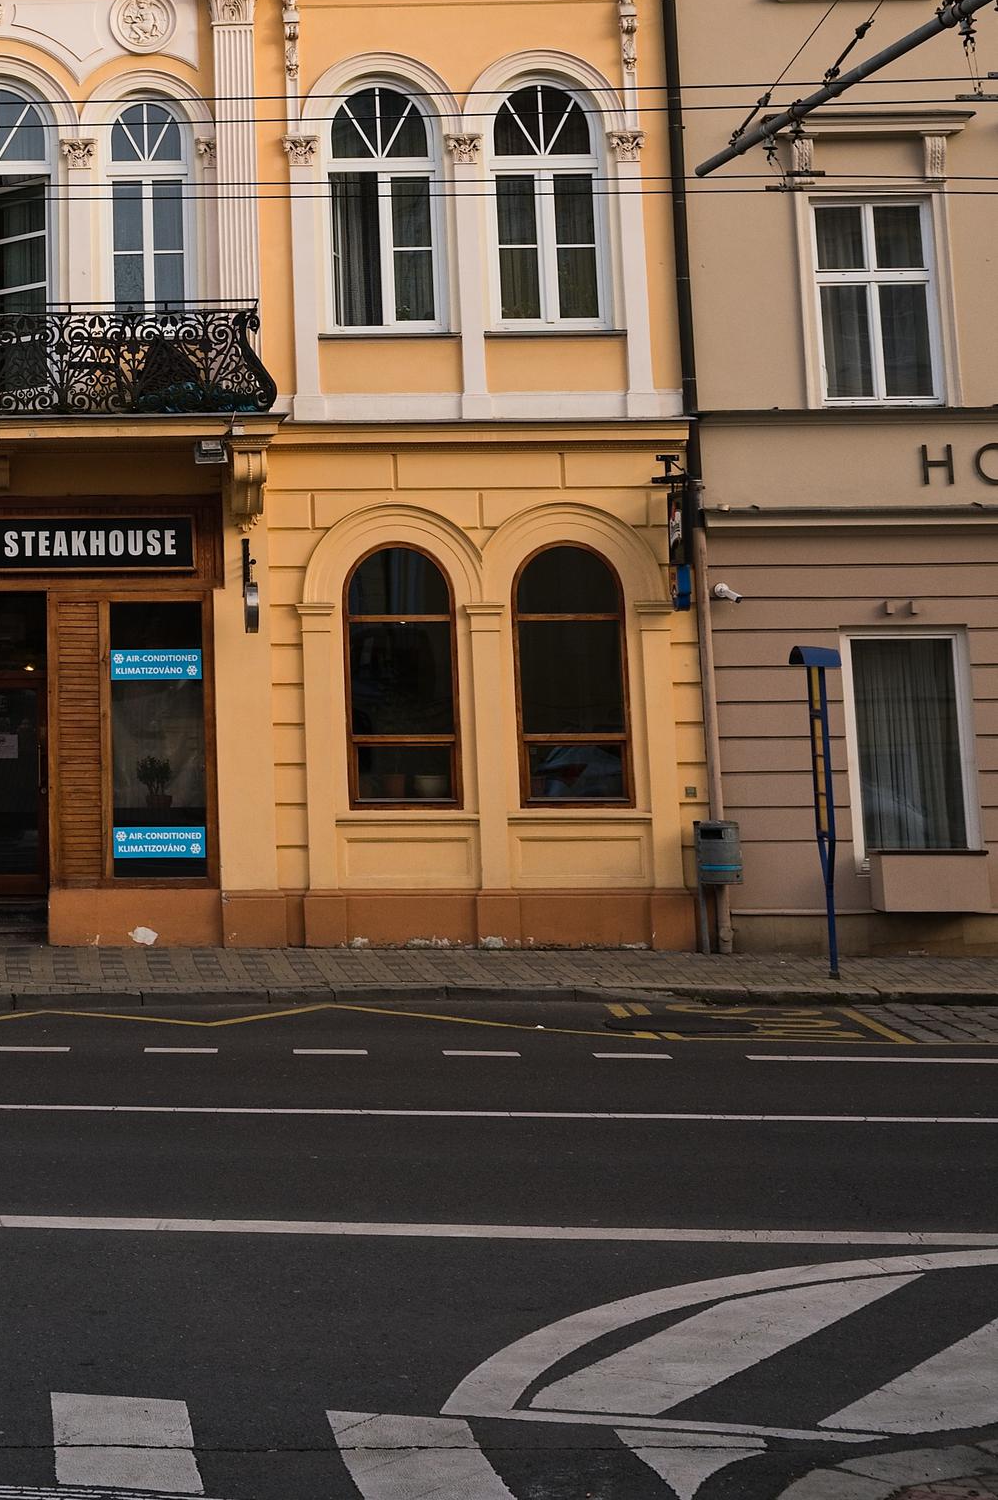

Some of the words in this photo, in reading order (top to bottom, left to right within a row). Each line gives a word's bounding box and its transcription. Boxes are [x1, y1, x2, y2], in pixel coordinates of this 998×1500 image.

[4, 529, 177, 557] STEAKHOUSE
[126, 654, 198, 662] AIR-CONDITIONED
[115, 665, 183, 675] KLIMATIZOVÁNO
[128, 832, 202, 840] AIR-CONDITIONED
[118, 843, 187, 853] KLIMATIZOVÁNO
